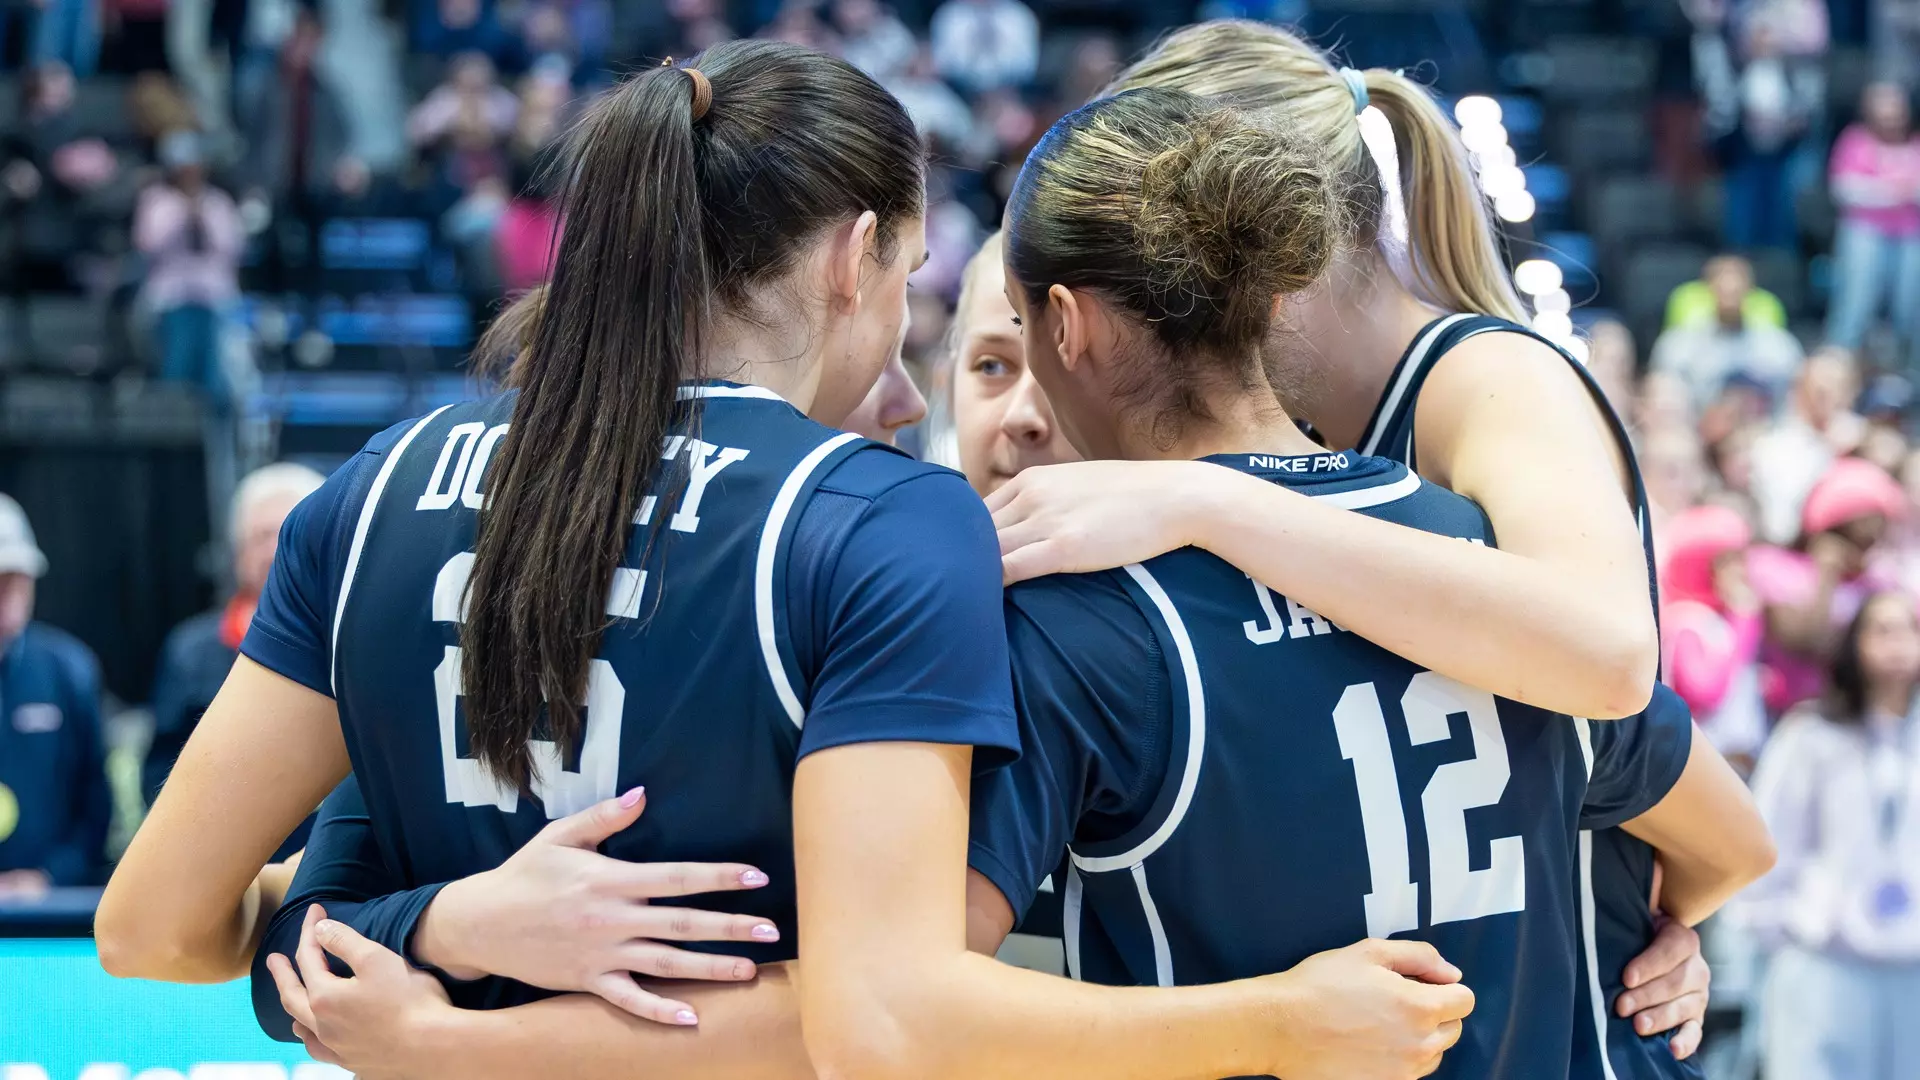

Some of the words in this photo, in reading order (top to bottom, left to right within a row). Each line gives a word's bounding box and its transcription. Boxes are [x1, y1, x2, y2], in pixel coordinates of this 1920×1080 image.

[1248, 455, 1310, 473] NIKE
[1311, 453, 1350, 473] PRO
[1331, 670, 1526, 940] 12
